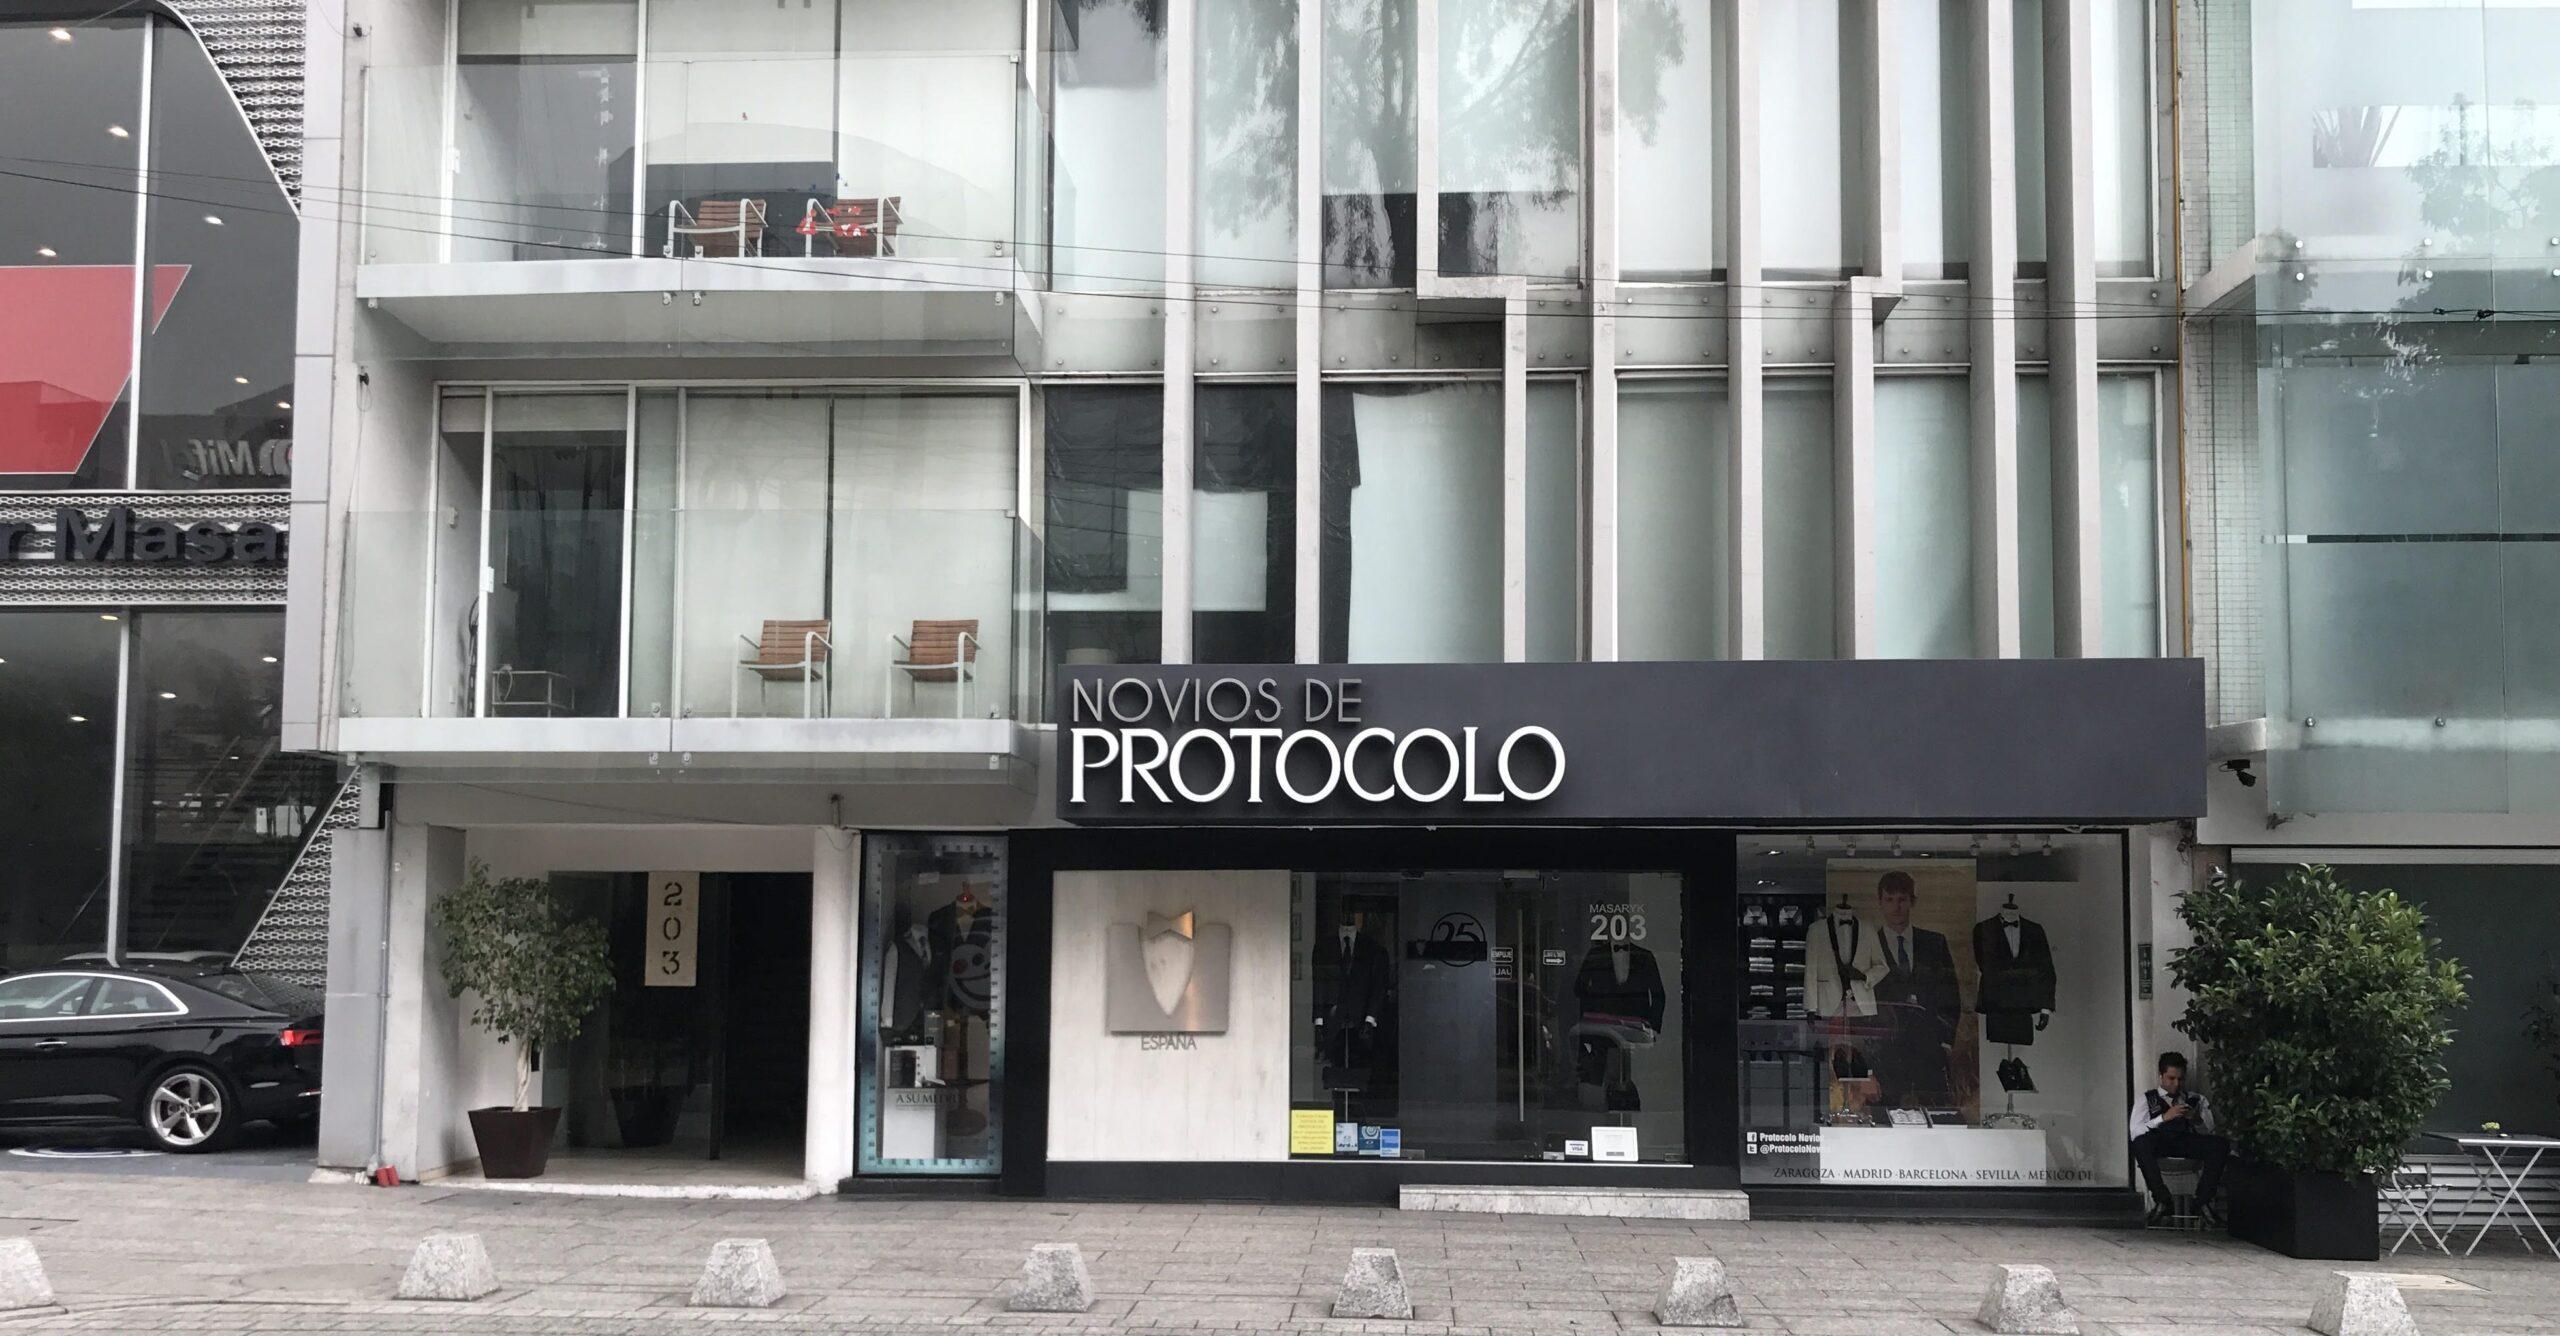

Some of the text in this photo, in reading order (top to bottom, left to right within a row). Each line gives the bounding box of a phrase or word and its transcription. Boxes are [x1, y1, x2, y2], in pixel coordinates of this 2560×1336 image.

[1072, 677, 1363, 723] NOVIOS DE
[1070, 724, 1567, 805] PROTOCOLO
[1589, 903, 1645, 914] MASARYK
[662, 881, 684, 976] 203
[1590, 914, 1648, 941] 203
[1759, 1132, 1797, 1143] Protocolo
[1773, 1167, 1835, 1179] ZARAGOZA
[1843, 1168, 1893, 1180] MADRID
[1899, 1168, 1968, 1181] BARCELONA
[1976, 1169, 2021, 1181] SEVILLA
